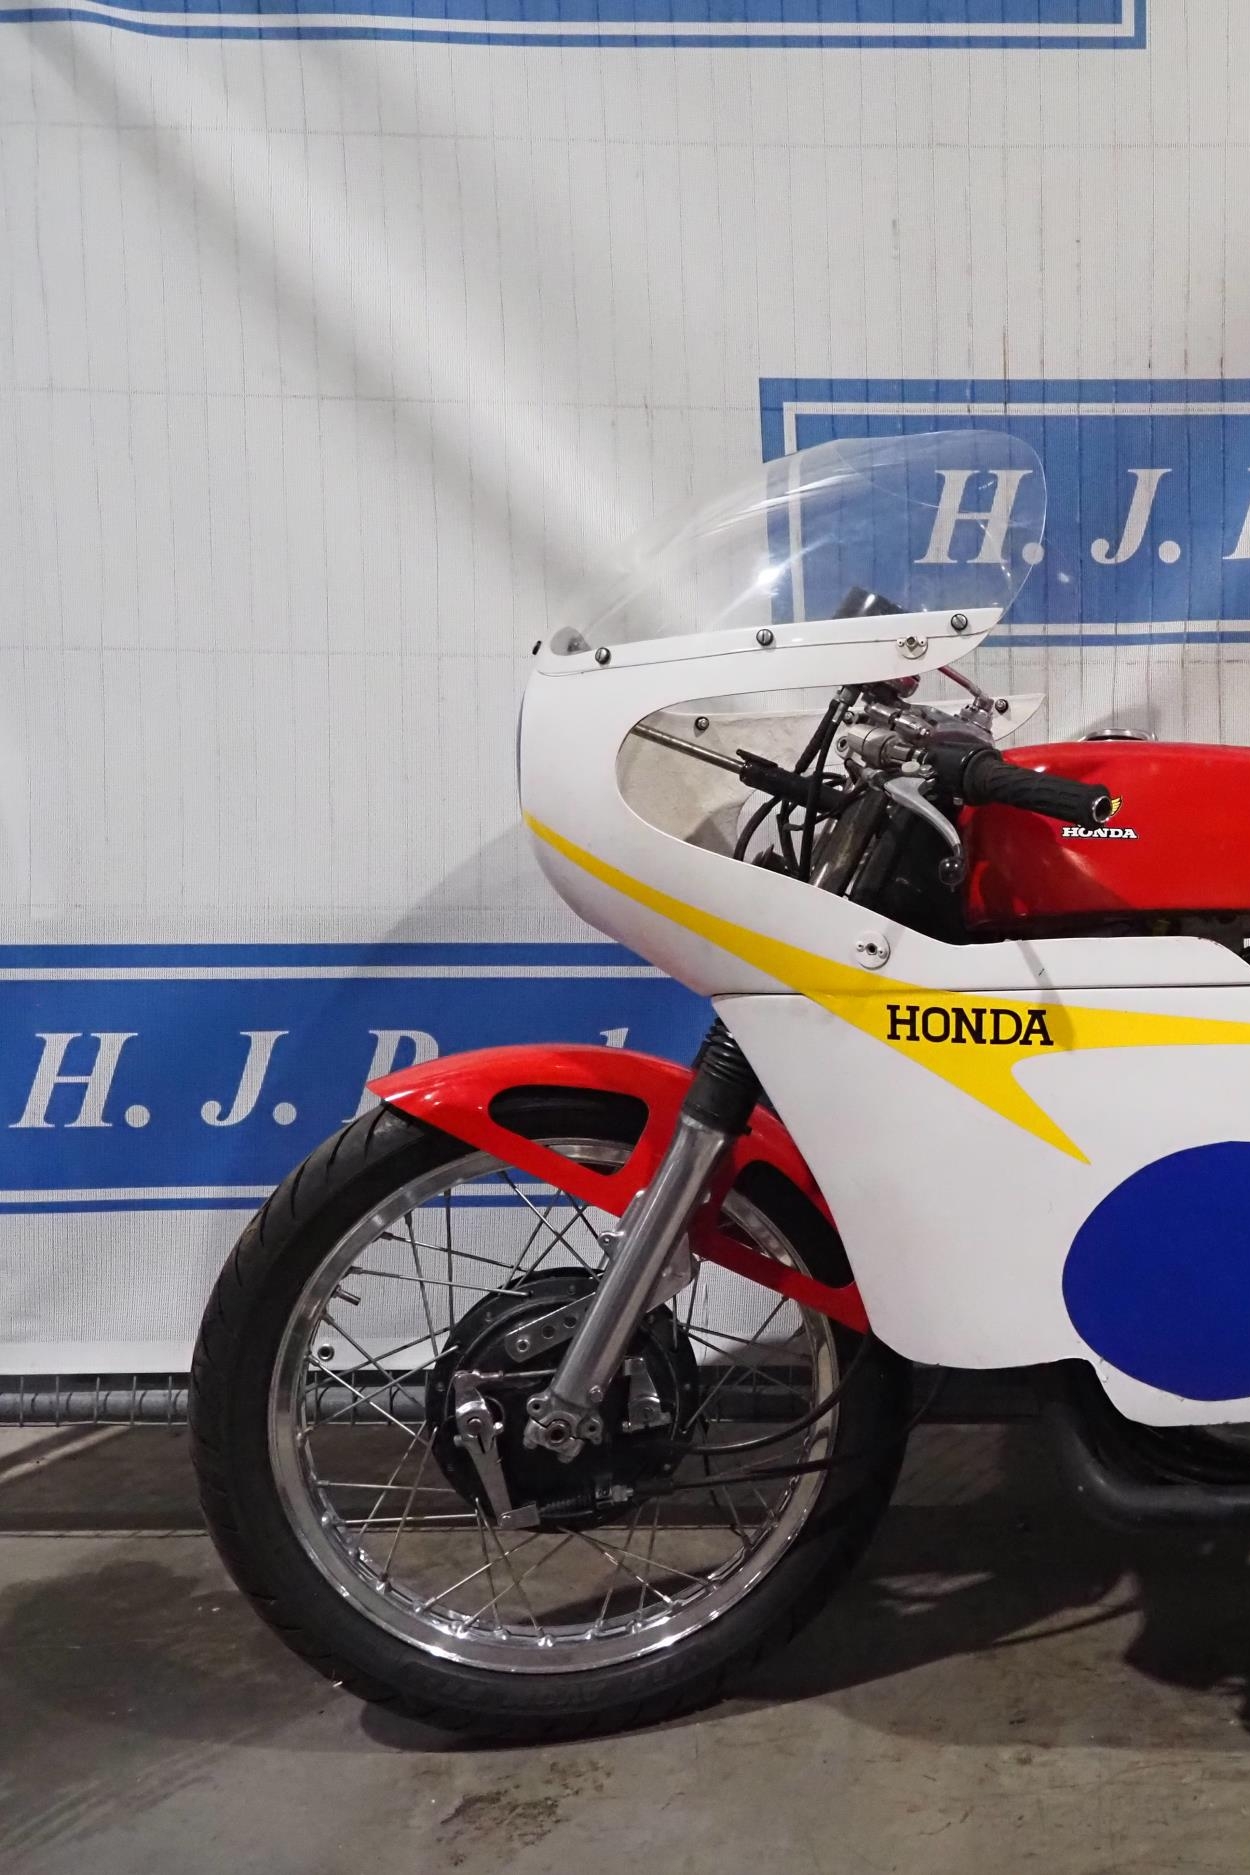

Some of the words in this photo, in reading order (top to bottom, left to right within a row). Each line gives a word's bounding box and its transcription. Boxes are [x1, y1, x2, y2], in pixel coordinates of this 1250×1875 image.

[913, 469, 1045, 565] H.
[1090, 467, 1182, 565] J.
[1061, 826, 1138, 839] HONDA
[886, 1004, 1054, 1046] HONDA
[9, 1032, 151, 1129] H.
[200, 1030, 297, 1127] J.
